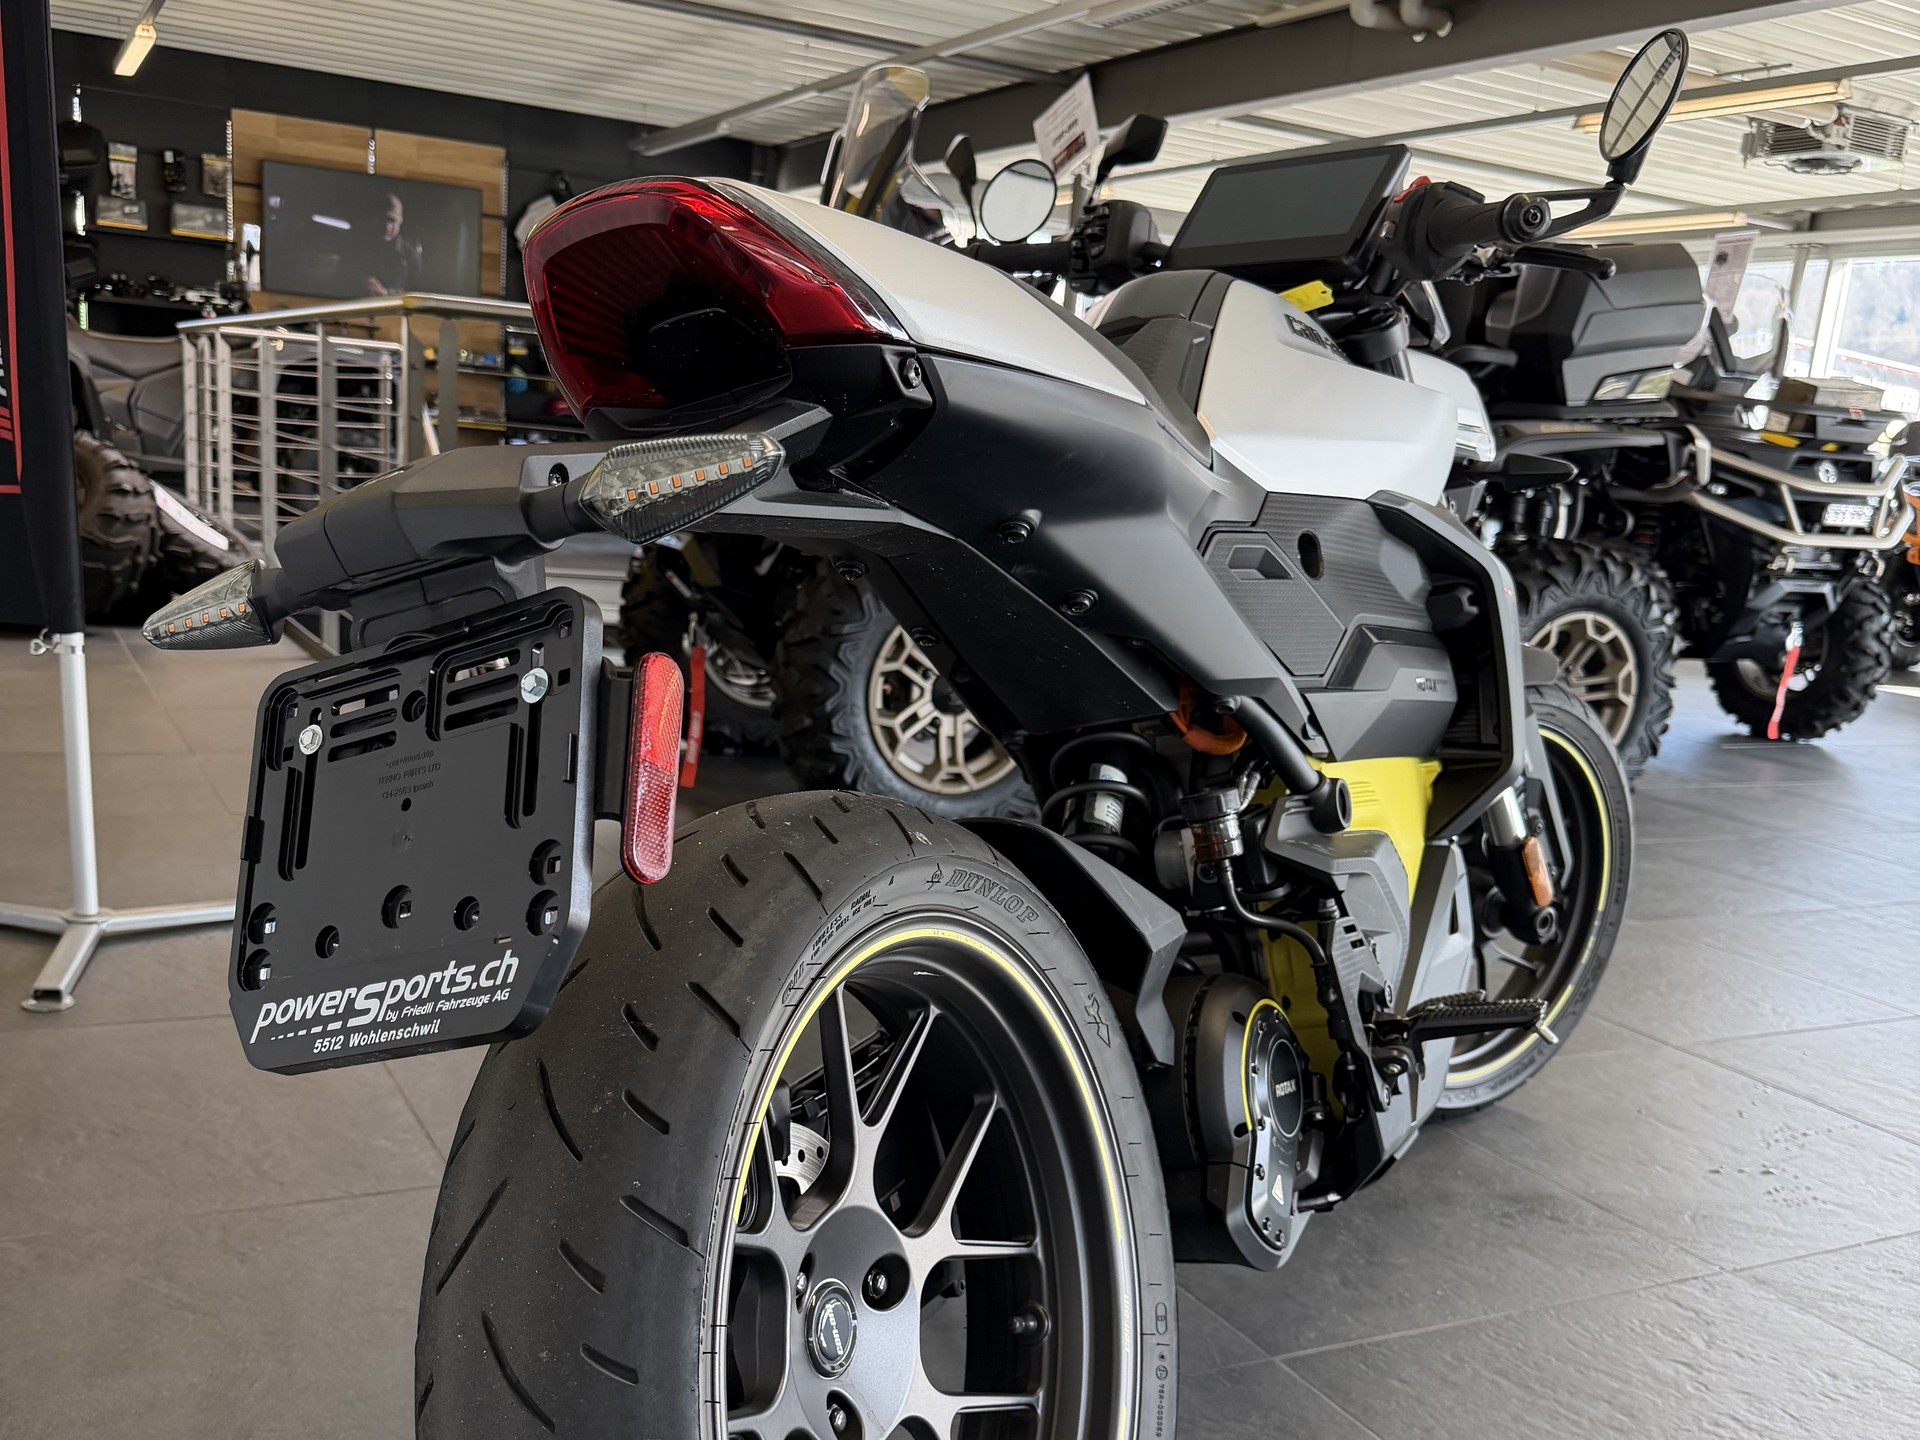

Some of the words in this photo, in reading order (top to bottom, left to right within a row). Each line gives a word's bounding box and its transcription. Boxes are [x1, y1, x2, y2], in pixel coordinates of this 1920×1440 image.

[945, 868, 1040, 923] DUNLOP
[385, 1008, 398, 1022] by
[401, 1001, 433, 1019] Friedli
[435, 994, 490, 1012] Fahrzeuge
[493, 988, 511, 1001] AG
[313, 1036, 344, 1054] 5512
[349, 1019, 441, 1048] Wohlenschwil
[1275, 1078, 1297, 1098] ROTAX
